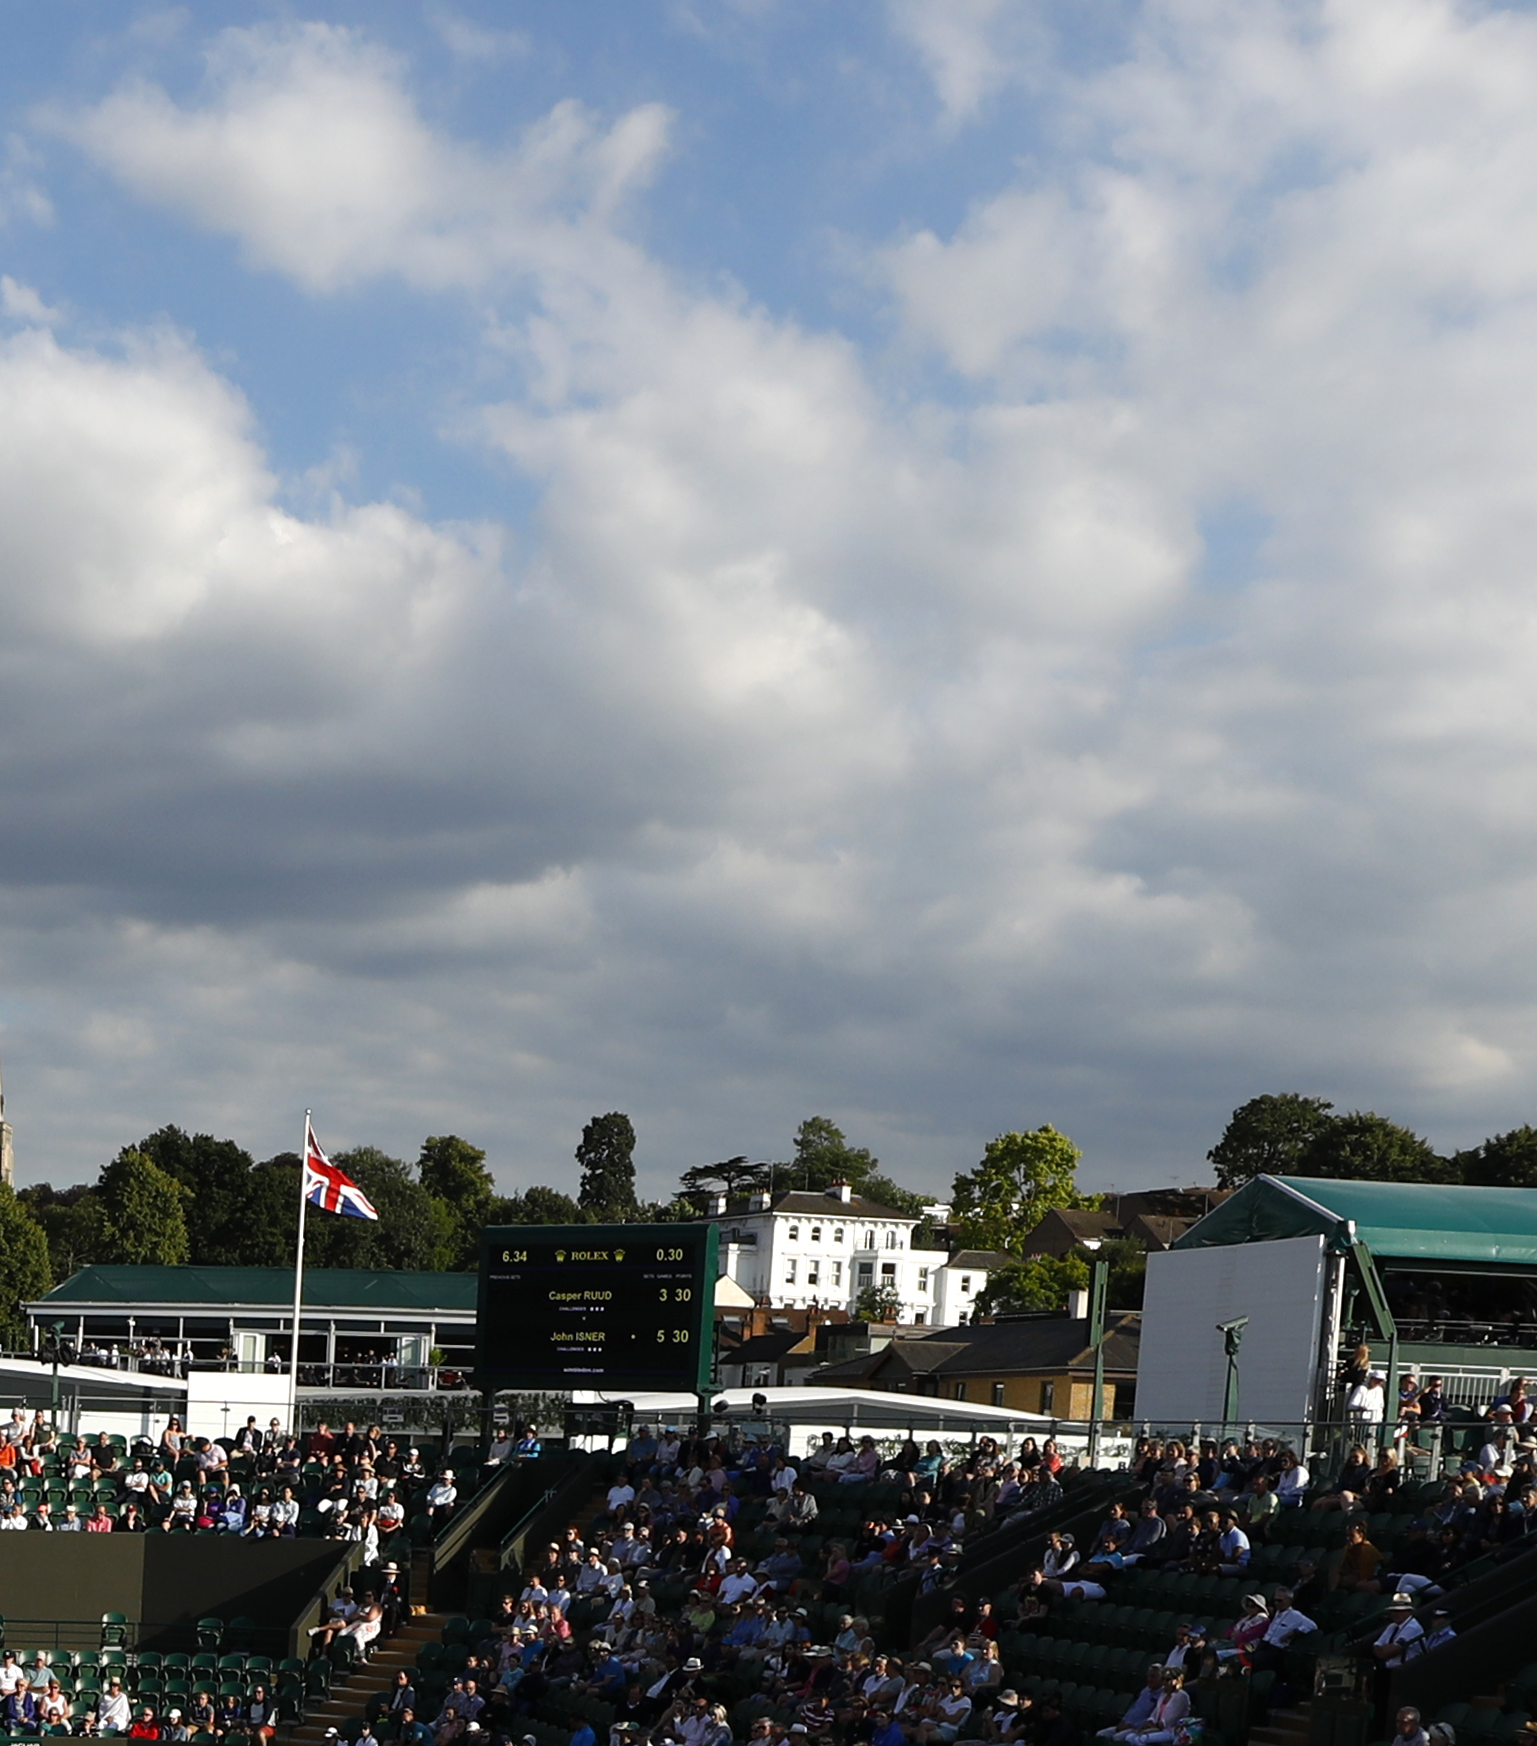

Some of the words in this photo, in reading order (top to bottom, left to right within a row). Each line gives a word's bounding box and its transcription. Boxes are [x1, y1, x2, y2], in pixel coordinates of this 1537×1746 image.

[502, 1250, 527, 1262] 6.34
[571, 1251, 609, 1261] ROLEX
[656, 1248, 683, 1261] 0.30
[548, 1291, 582, 1302] Casper
[583, 1290, 612, 1300] RUUD
[659, 1288, 668, 1301] 3
[674, 1288, 692, 1301] 30
[550, 1332, 573, 1341] John
[575, 1332, 606, 1341] ISNER
[656, 1330, 665, 1343] 5
[672, 1330, 689, 1343] 30
